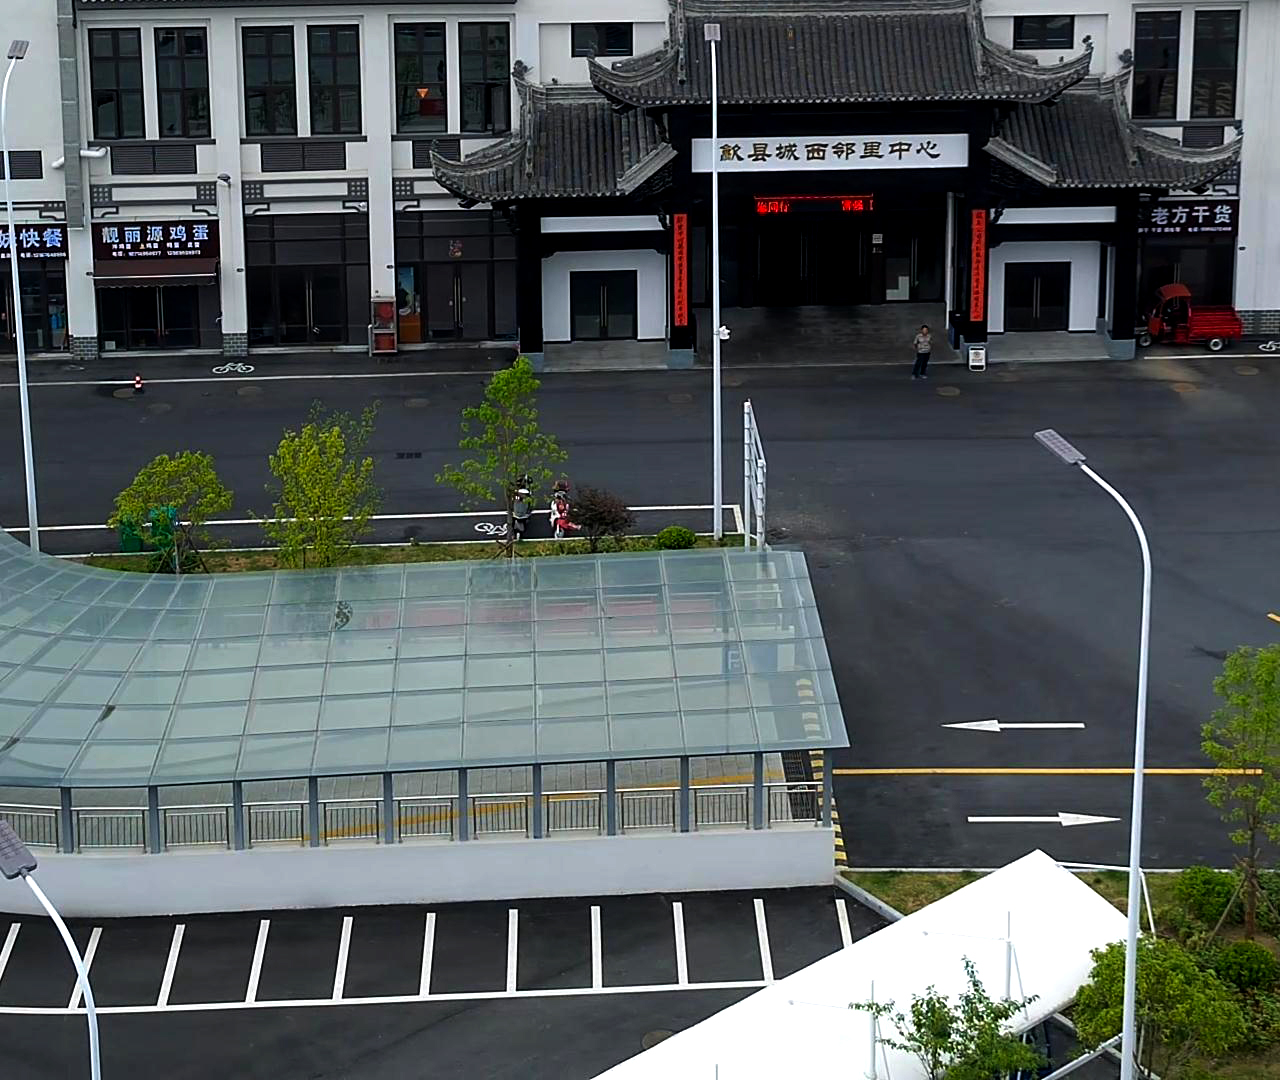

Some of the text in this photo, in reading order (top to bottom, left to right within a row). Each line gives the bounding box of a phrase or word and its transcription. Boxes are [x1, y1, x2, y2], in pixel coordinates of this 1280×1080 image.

[720, 140, 941, 162] 歙县城西邻里中心
[1151, 204, 1233, 225] 老方干货
[102, 224, 209, 244] 靓丽源鸡蛋
